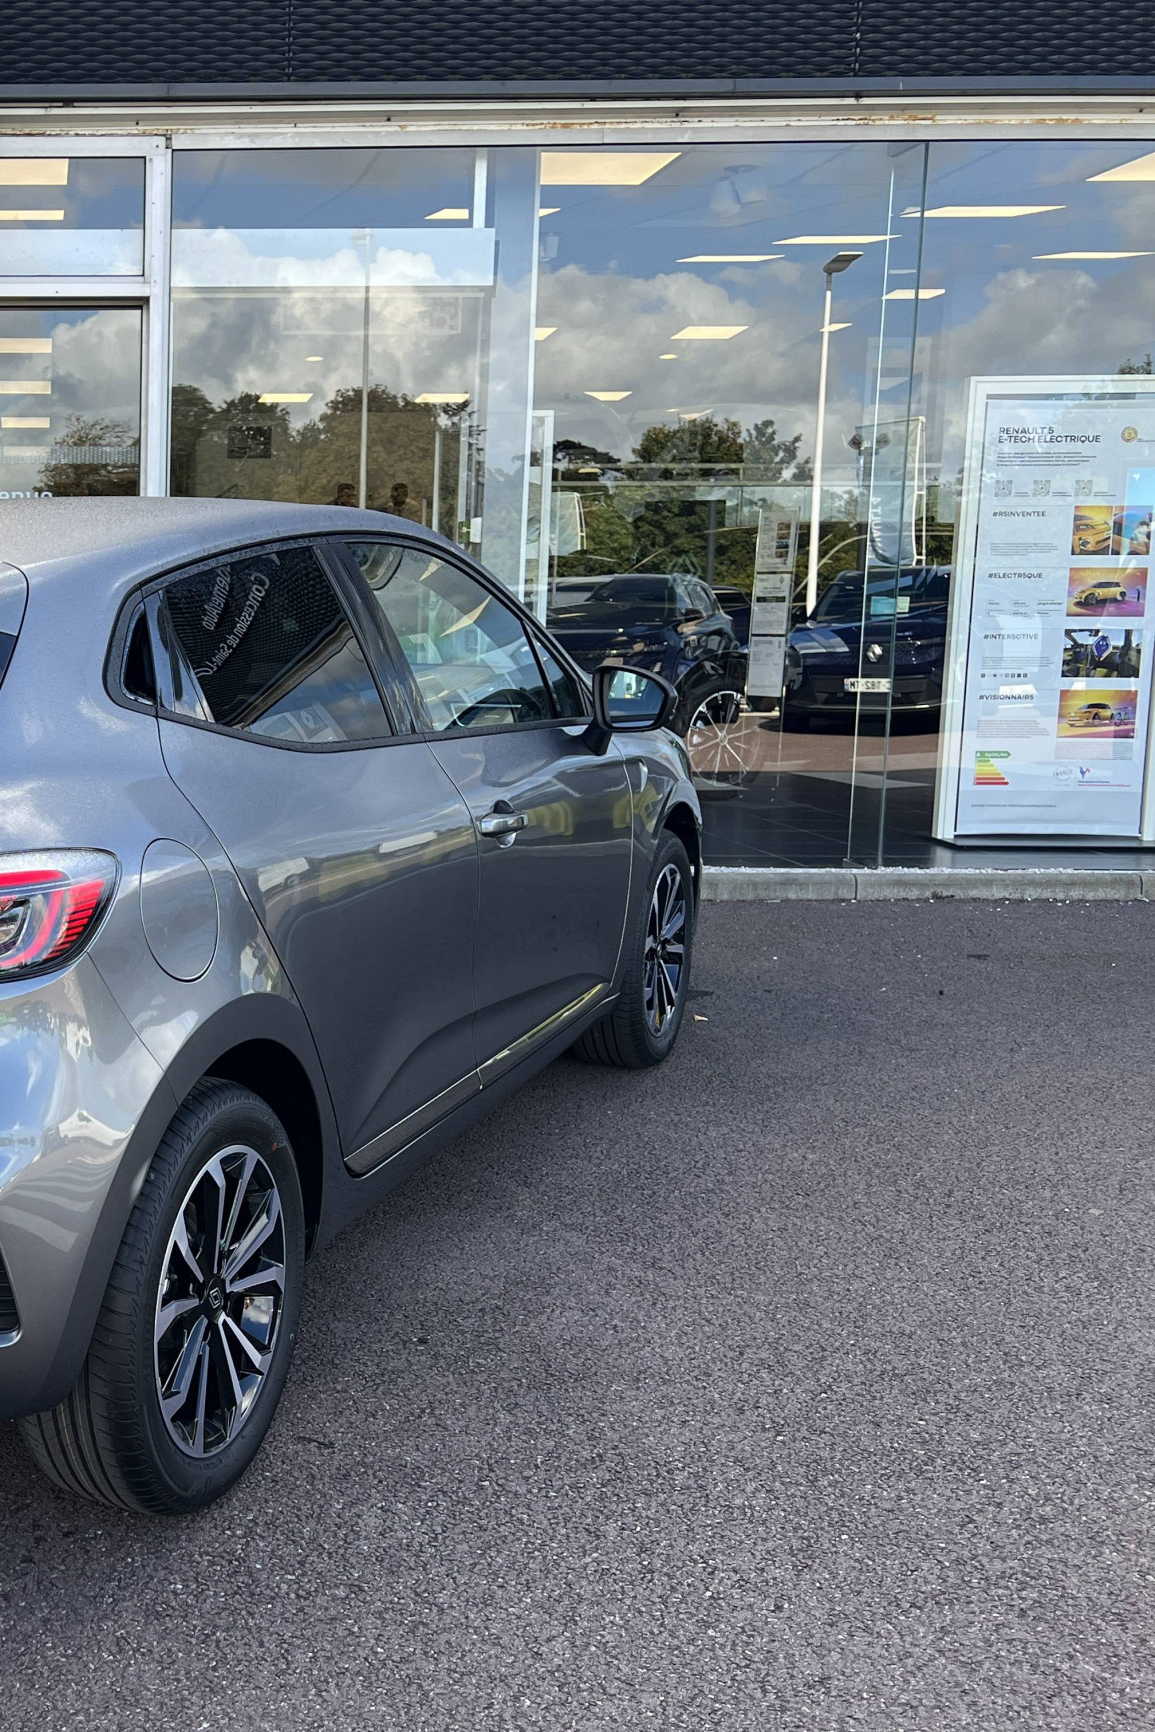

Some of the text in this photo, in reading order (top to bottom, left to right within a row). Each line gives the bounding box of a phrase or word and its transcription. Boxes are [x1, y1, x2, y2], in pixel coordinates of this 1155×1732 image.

[998, 426, 1055, 435] RENAULT 5
[998, 435, 1035, 444] E-TECH
